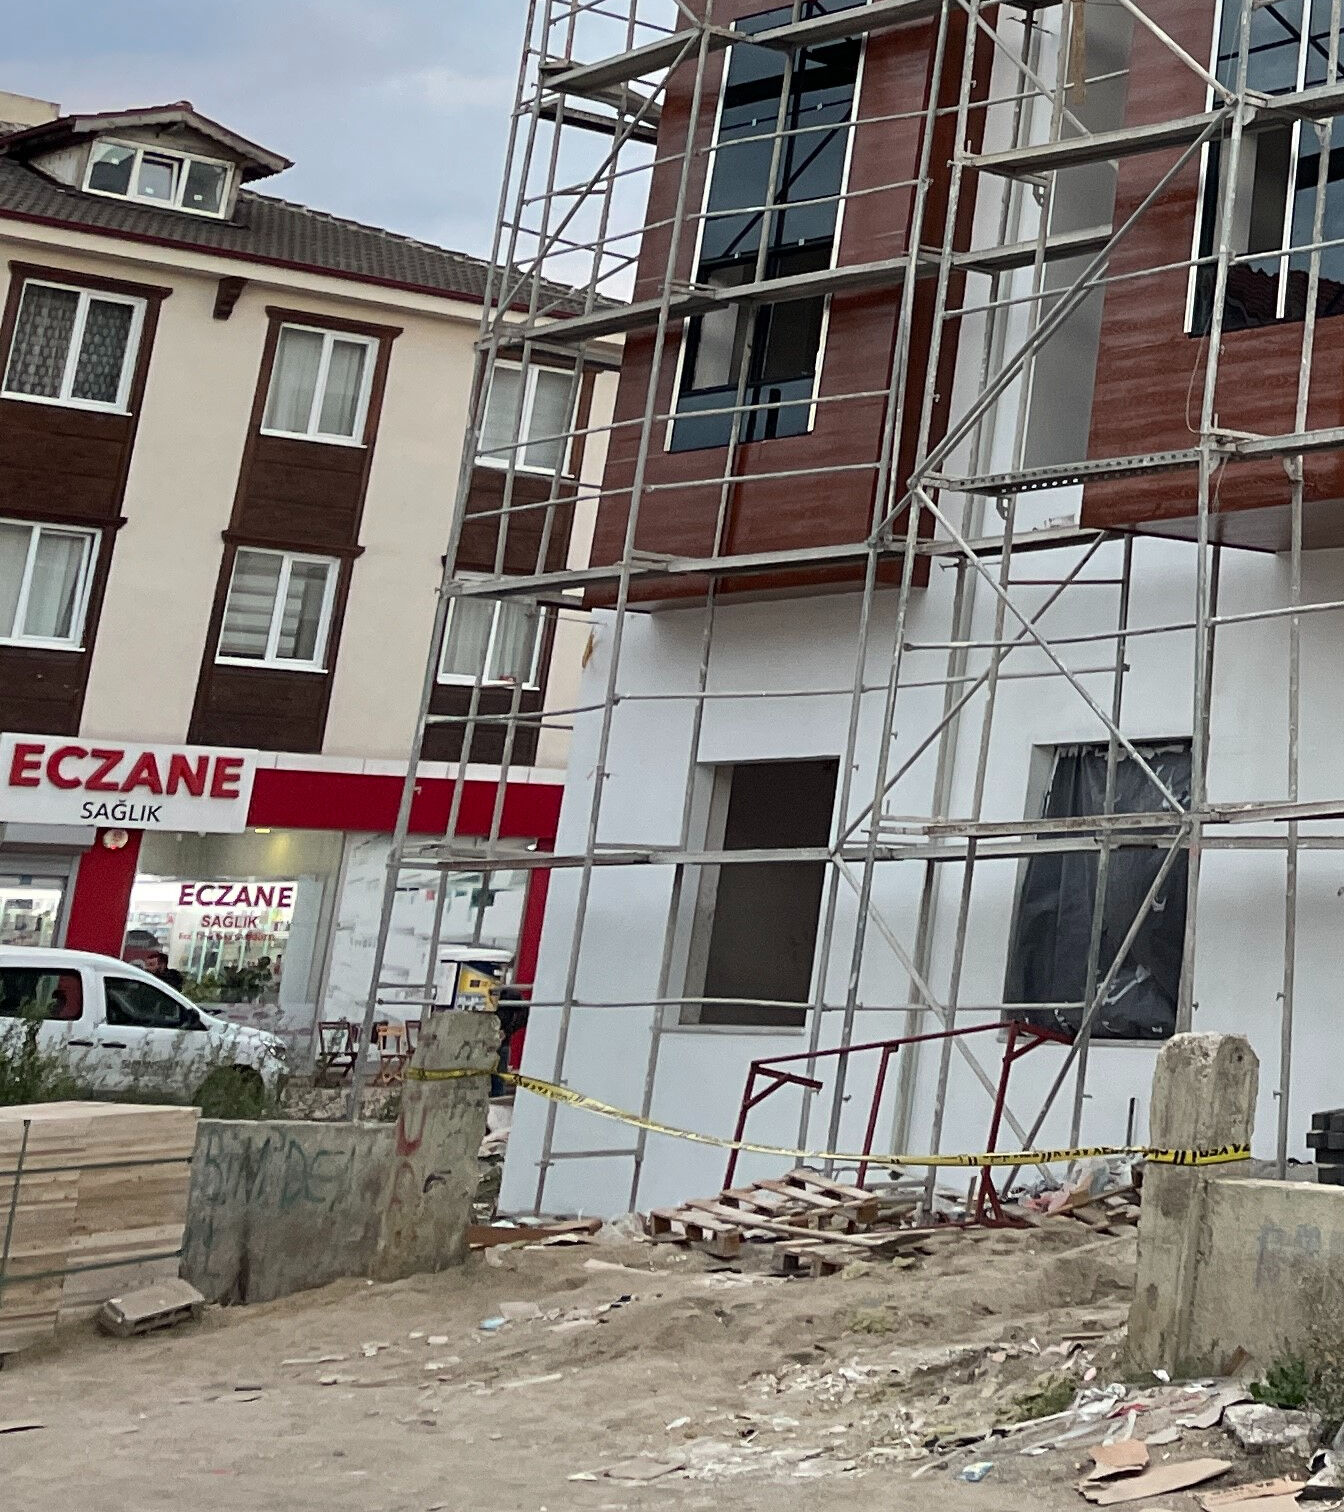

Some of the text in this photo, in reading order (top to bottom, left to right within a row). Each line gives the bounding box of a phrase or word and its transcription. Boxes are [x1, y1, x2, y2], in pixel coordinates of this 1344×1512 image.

[9, 743, 244, 799] ECZANE
[80, 799, 163, 823] SAĞLIK
[178, 883, 293, 908] ECZANE
[200, 911, 258, 929] SAĞLIK
